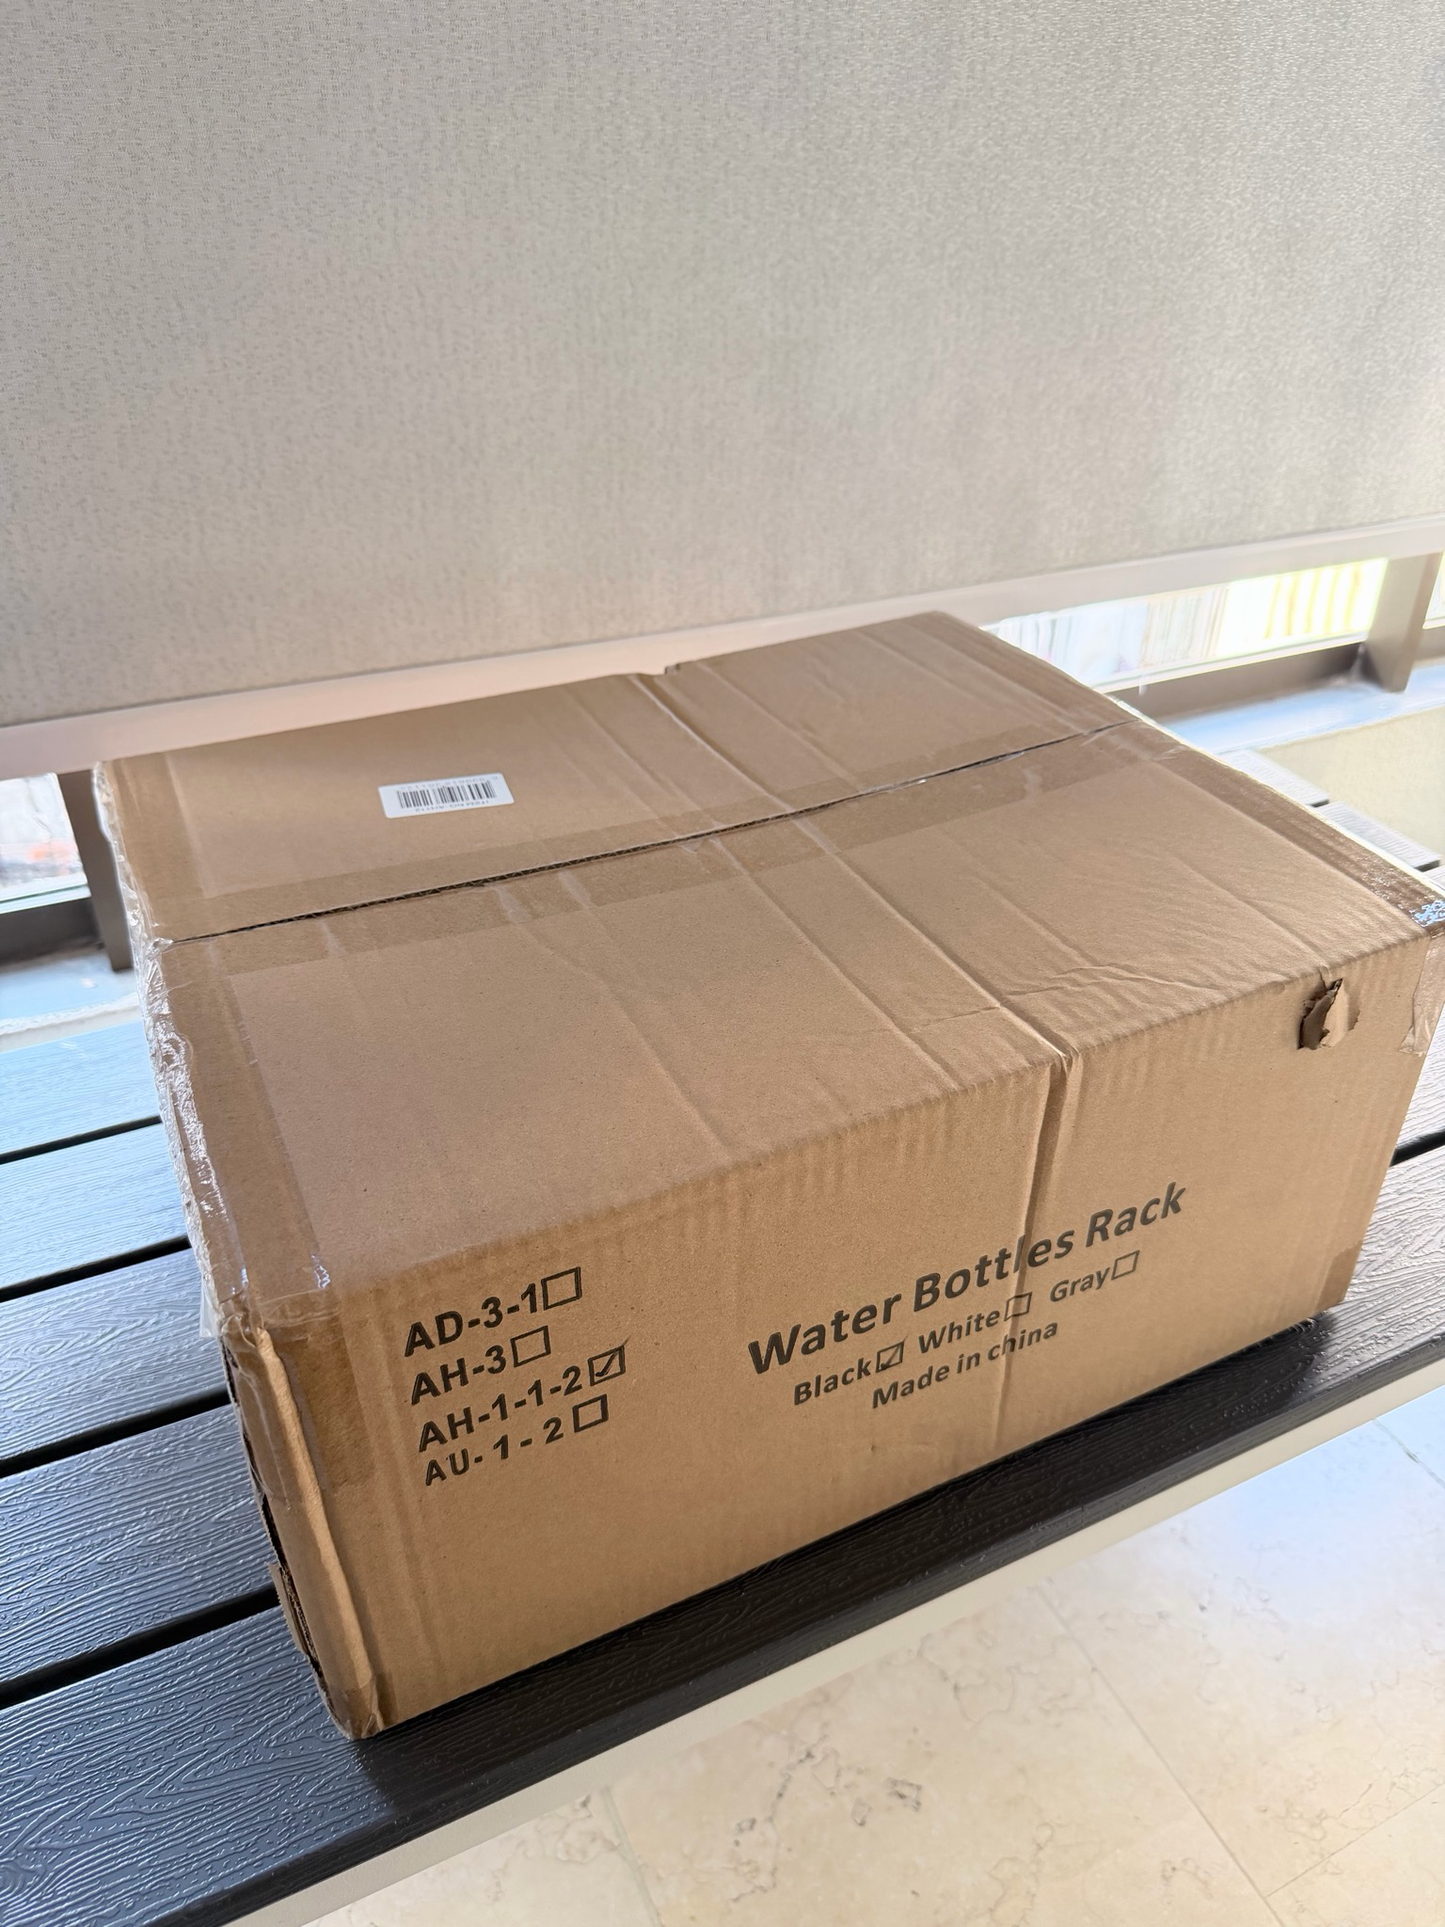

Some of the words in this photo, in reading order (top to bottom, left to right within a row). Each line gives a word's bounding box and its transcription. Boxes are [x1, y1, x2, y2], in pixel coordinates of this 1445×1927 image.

[404, 1282, 537, 1357] AD-3-1
[748, 1293, 902, 1375] Water
[913, 1230, 1075, 1312] Bottles
[1085, 1181, 1187, 1248] Rack
[411, 1345, 507, 1405] AH-3
[793, 1357, 872, 1406] Black
[918, 1309, 1000, 1354] White
[1050, 1267, 1111, 1302] Gray
[872, 1365, 950, 1409] Made
[957, 1352, 980, 1374] in
[987, 1322, 1058, 1361] china
[418, 1365, 583, 1453] AH-1-1-2
